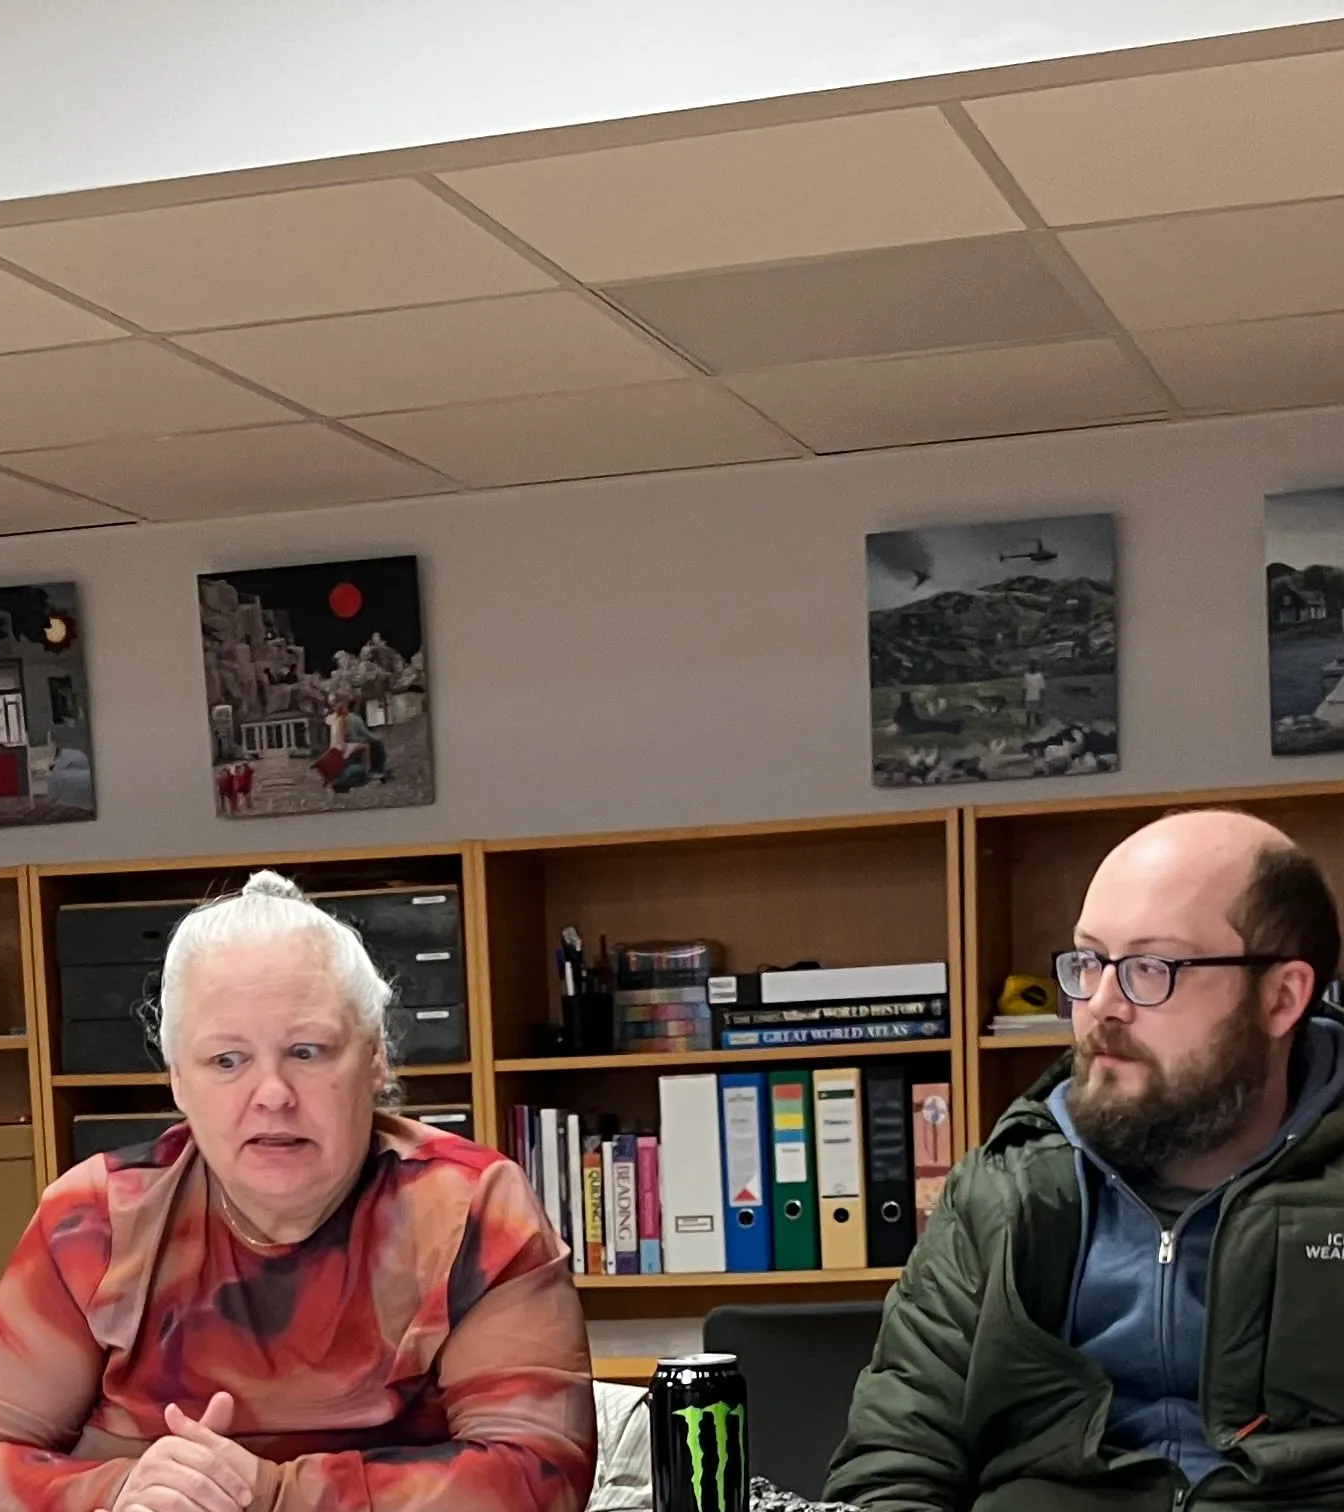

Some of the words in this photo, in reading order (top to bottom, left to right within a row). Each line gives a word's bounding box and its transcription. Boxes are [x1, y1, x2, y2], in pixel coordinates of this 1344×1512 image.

[811, 1026, 864, 1041] WORLD
[867, 1022, 910, 1037] ATLAS
[615, 1165, 632, 1240] READING
